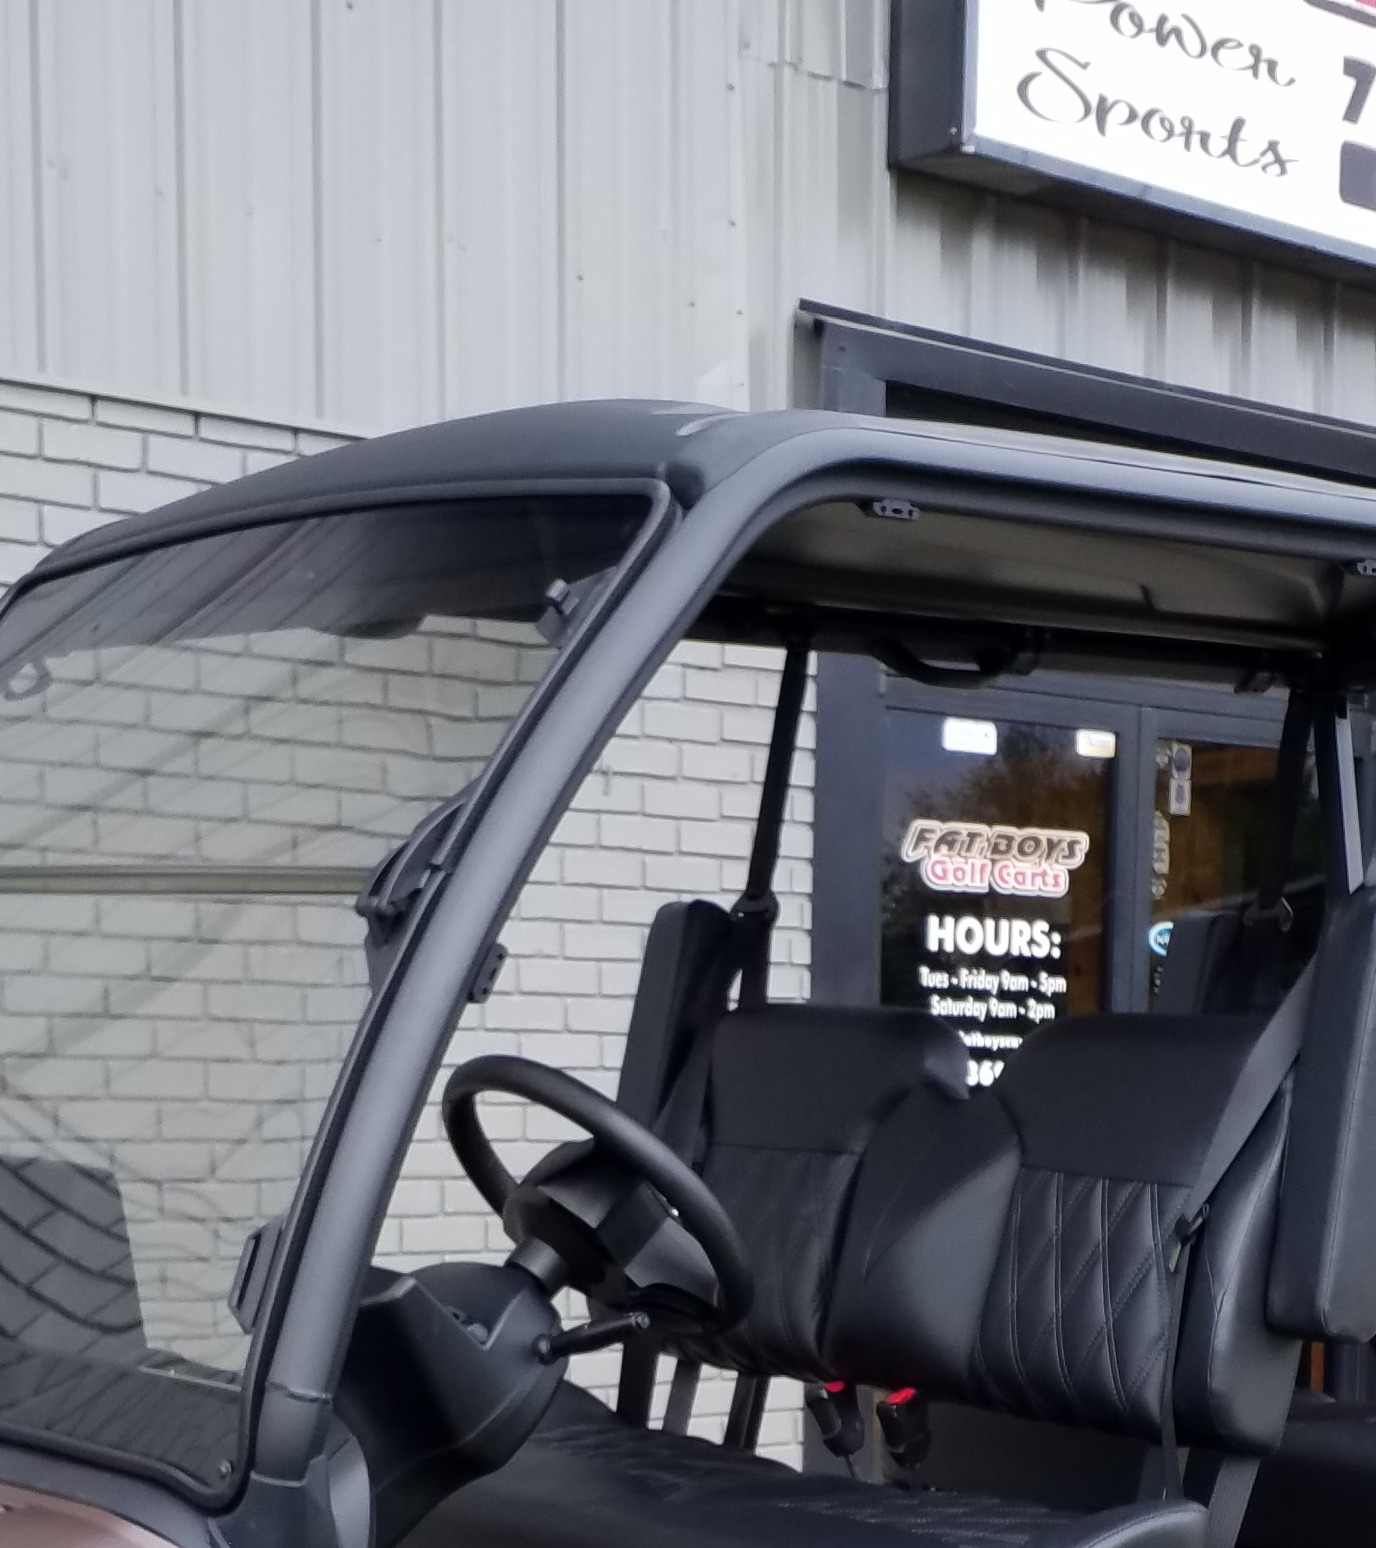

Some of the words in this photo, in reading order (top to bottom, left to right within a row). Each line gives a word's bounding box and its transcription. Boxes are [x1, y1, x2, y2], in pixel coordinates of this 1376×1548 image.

[1034, 0, 1297, 88] ower
[1016, 47, 1300, 177] Sports
[909, 824, 985, 858] FAT
[989, 829, 1085, 864] BOYS
[928, 857, 991, 886] Golf
[994, 861, 1065, 891] Carts
[926, 914, 1062, 959] HOURS:
[918, 965, 950, 988] Tues
[959, 967, 999, 995] Friday
[1000, 969, 1029, 992] 9am
[1038, 971, 1067, 997] 5pm
[930, 994, 987, 1022] Saturday
[989, 997, 1017, 1018] 9am
[1027, 998, 1055, 1024] 2pm
